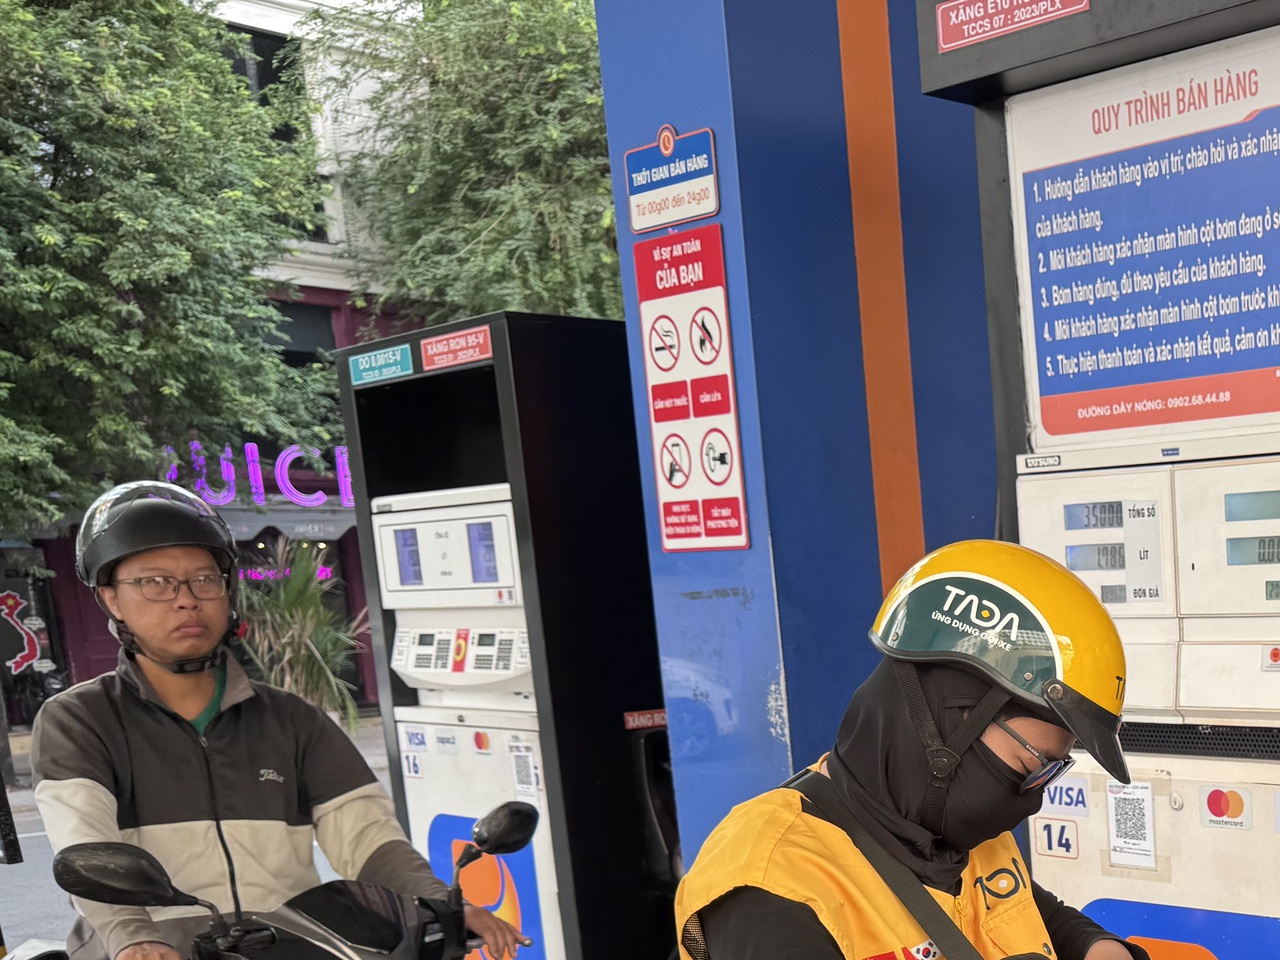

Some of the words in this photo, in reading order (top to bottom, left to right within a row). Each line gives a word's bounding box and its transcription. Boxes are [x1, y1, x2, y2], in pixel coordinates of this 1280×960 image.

[949, 3, 984, 25] XĂNG
[987, 0, 1010, 13] E10
[962, 18, 991, 37] TCCS
[993, 14, 1005, 28] 07
[1013, 0, 1062, 22] 2023/PLX
[1092, 103, 1120, 135] QUY
[1125, 91, 1171, 127] TRÌNH
[1176, 78, 1208, 115] BÁN
[1213, 69, 1259, 106] HÀNG
[651, 164, 670, 181] GIAN
[670, 158, 686, 178] BÁN
[686, 154, 709, 172] HÀNG
[1033, 182, 1041, 202] 1.
[1073, 168, 1089, 193] dẫn
[1090, 165, 1117, 190] khách
[1118, 161, 1141, 186] hàng
[1142, 156, 1158, 178] vào
[1160, 152, 1169, 178] vị
[1185, 144, 1208, 169] chào
[1210, 138, 1224, 163] hỏi
[1226, 136, 1238, 159] và
[1240, 133, 1257, 157] xác
[687, 188, 710, 205] 24g00
[1052, 210, 1077, 234] khách
[1079, 207, 1102, 231] hàng.
[672, 243, 682, 257] AN
[682, 239, 701, 255] TOÀN
[1038, 252, 1046, 272] 2.
[1065, 244, 1091, 267] khách
[1092, 241, 1114, 265] hàng
[1115, 236, 1131, 258] xác
[1132, 231, 1154, 257] nhận
[1156, 227, 1176, 250] màn
[1177, 223, 1198, 246] hình
[1199, 219, 1214, 246] cột
[1216, 218, 1236, 239] bơm
[1238, 213, 1262, 238] đang
[656, 263, 679, 290] CỦA
[680, 262, 703, 286] BẠN
[1040, 287, 1049, 307] 3.
[1072, 280, 1093, 305] hàng
[1209, 253, 1237, 278] khách
[1239, 250, 1265, 276] hàng.
[1043, 322, 1051, 341] 4.
[1070, 315, 1096, 337] khách
[1097, 312, 1118, 336] hàng
[1119, 308, 1135, 330] xác
[1136, 305, 1158, 330] nhận
[1160, 301, 1179, 324] màn
[1181, 297, 1201, 320] hình
[1203, 295, 1217, 321] cột
[1219, 294, 1239, 315] bơm
[358, 357, 370, 370] DO
[1046, 356, 1054, 376] 5.
[1079, 350, 1097, 375] hiện
[1098, 346, 1122, 369] thanh
[1123, 344, 1142, 365] toán
[1144, 341, 1154, 362] và
[1156, 339, 1171, 361] xác
[1173, 336, 1195, 362] nhận
[1197, 330, 1211, 355] kết
[1078, 405, 1111, 418] ĐƯỜNG
[1112, 402, 1133, 414] DÂY
[1134, 398, 1166, 412] NÓNG:
[1167, 391, 1231, 408] 0902.68.44.88
[1139, 548, 1149, 560] LÍT
[943, 585, 1020, 641] TADA
[931, 610, 952, 626] ỨNG
[951, 619, 980, 637] DỤNG
[980, 629, 999, 646] GỌI
[998, 639, 1013, 652] XE
[406, 731, 427, 746] VISA
[405, 755, 419, 774] 16
[1046, 786, 1087, 809] VISA
[1209, 819, 1243, 827] mastercard
[1043, 823, 1072, 853] 14
